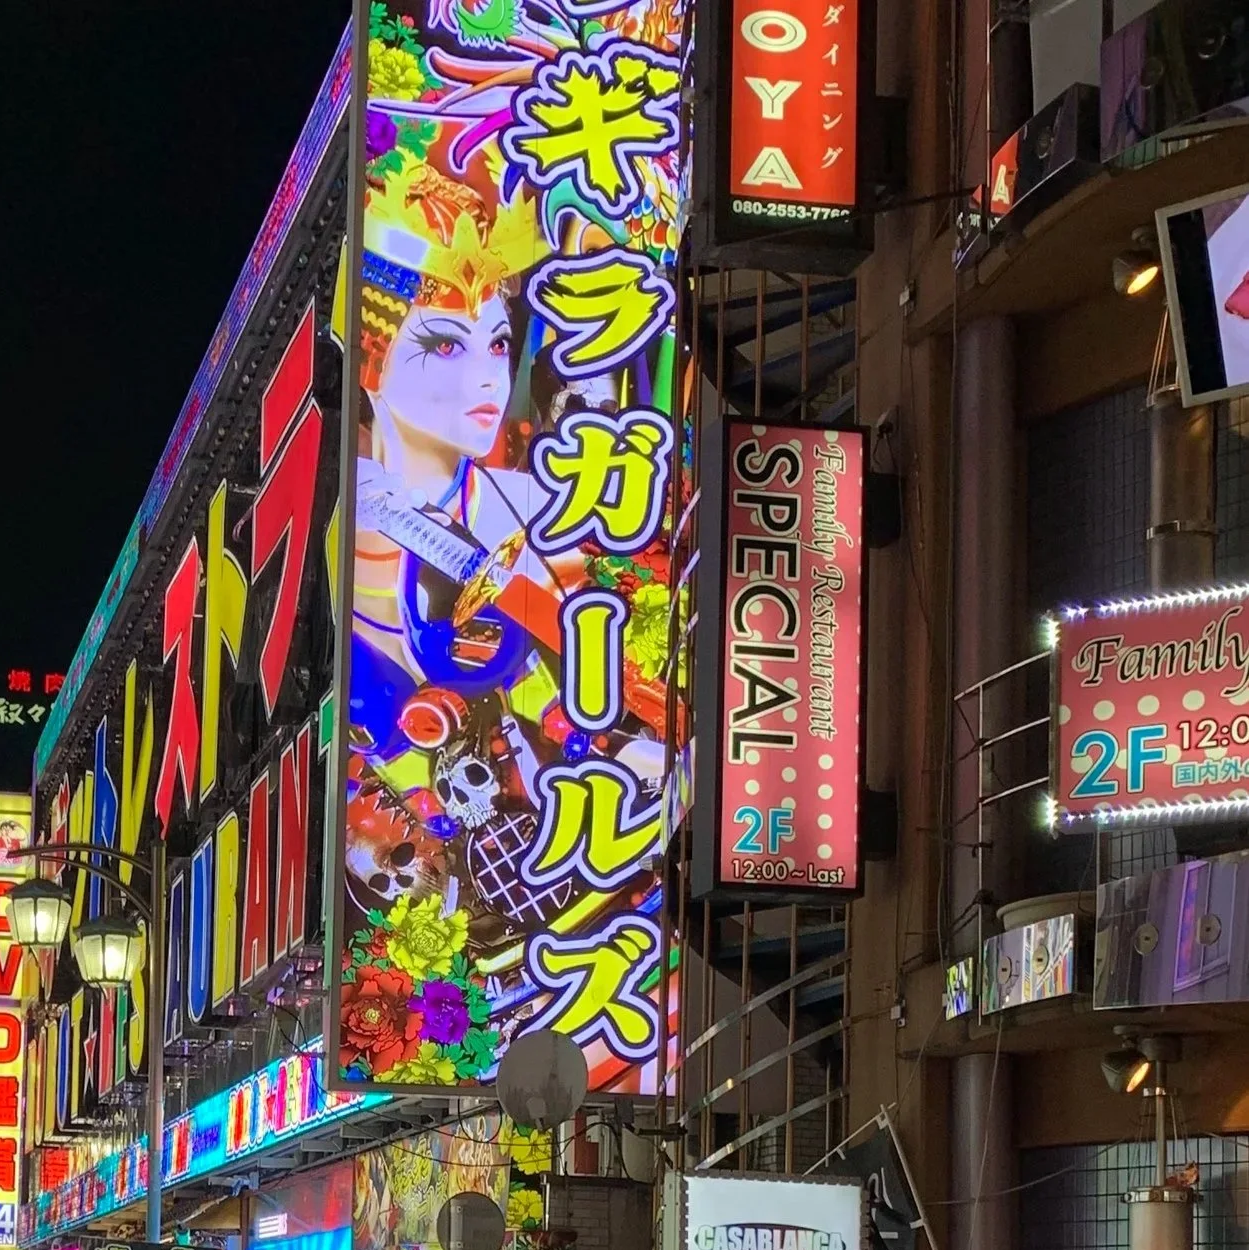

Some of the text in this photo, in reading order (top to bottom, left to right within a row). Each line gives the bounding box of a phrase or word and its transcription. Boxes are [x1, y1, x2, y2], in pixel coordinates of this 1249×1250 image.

[821, 4, 846, 169] ダイニング
[503, 0, 682, 1064] ギラガールズ
[729, 439, 803, 765] SPECIAL
[802, 444, 853, 742] Family Restaurant
[1069, 723, 1168, 798] 2F
[1071, 605, 1249, 697] Family
[98, 690, 333, 1095] RESAURANT
[732, 806, 795, 854] 2F
